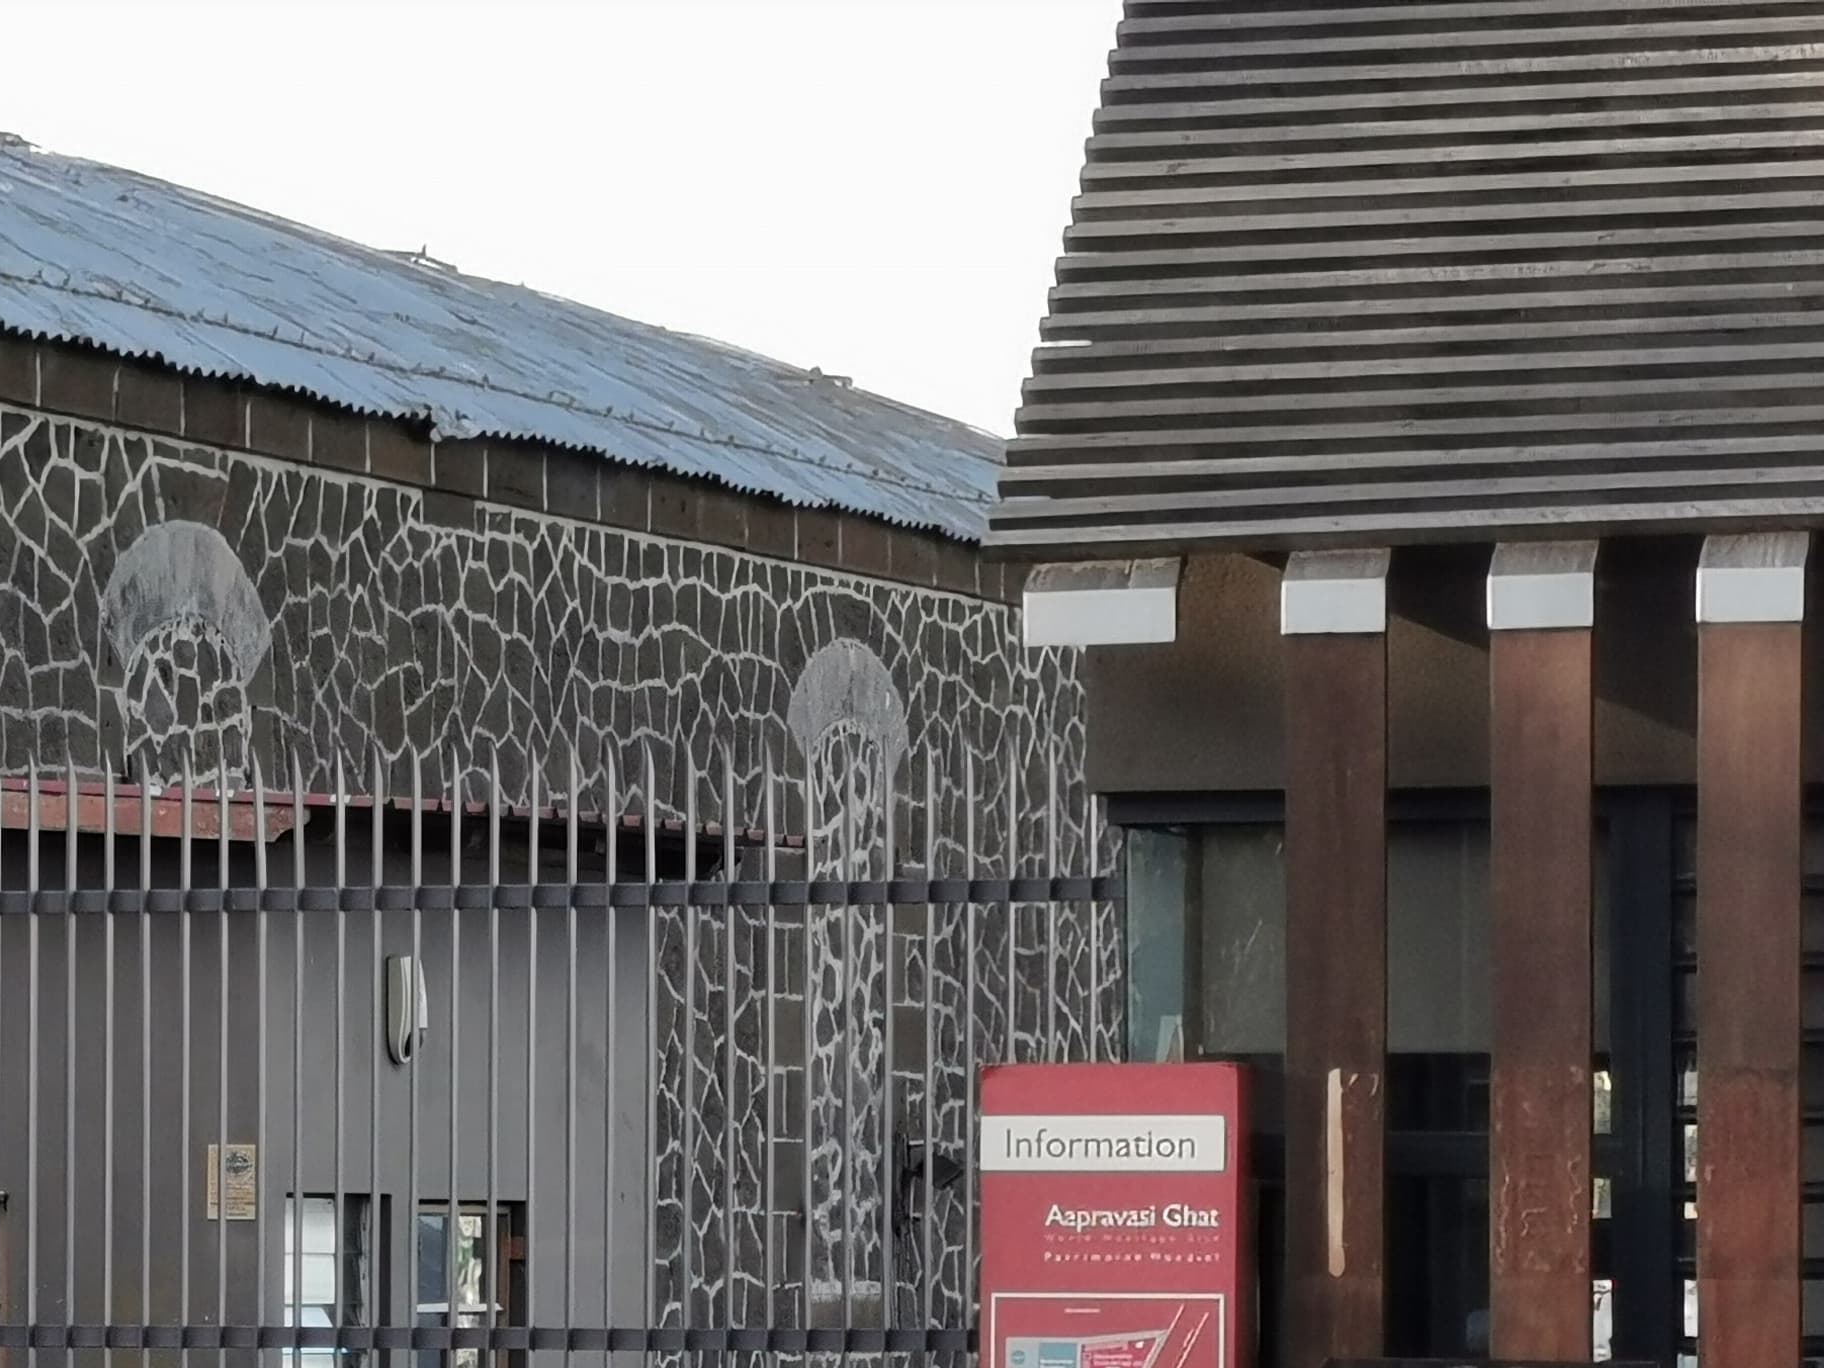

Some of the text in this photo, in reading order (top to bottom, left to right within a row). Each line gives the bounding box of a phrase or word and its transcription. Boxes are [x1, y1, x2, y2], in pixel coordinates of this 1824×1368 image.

[1005, 1128, 1196, 1158] Information
[1044, 1203, 1220, 1232] Aapravasi Ghat
